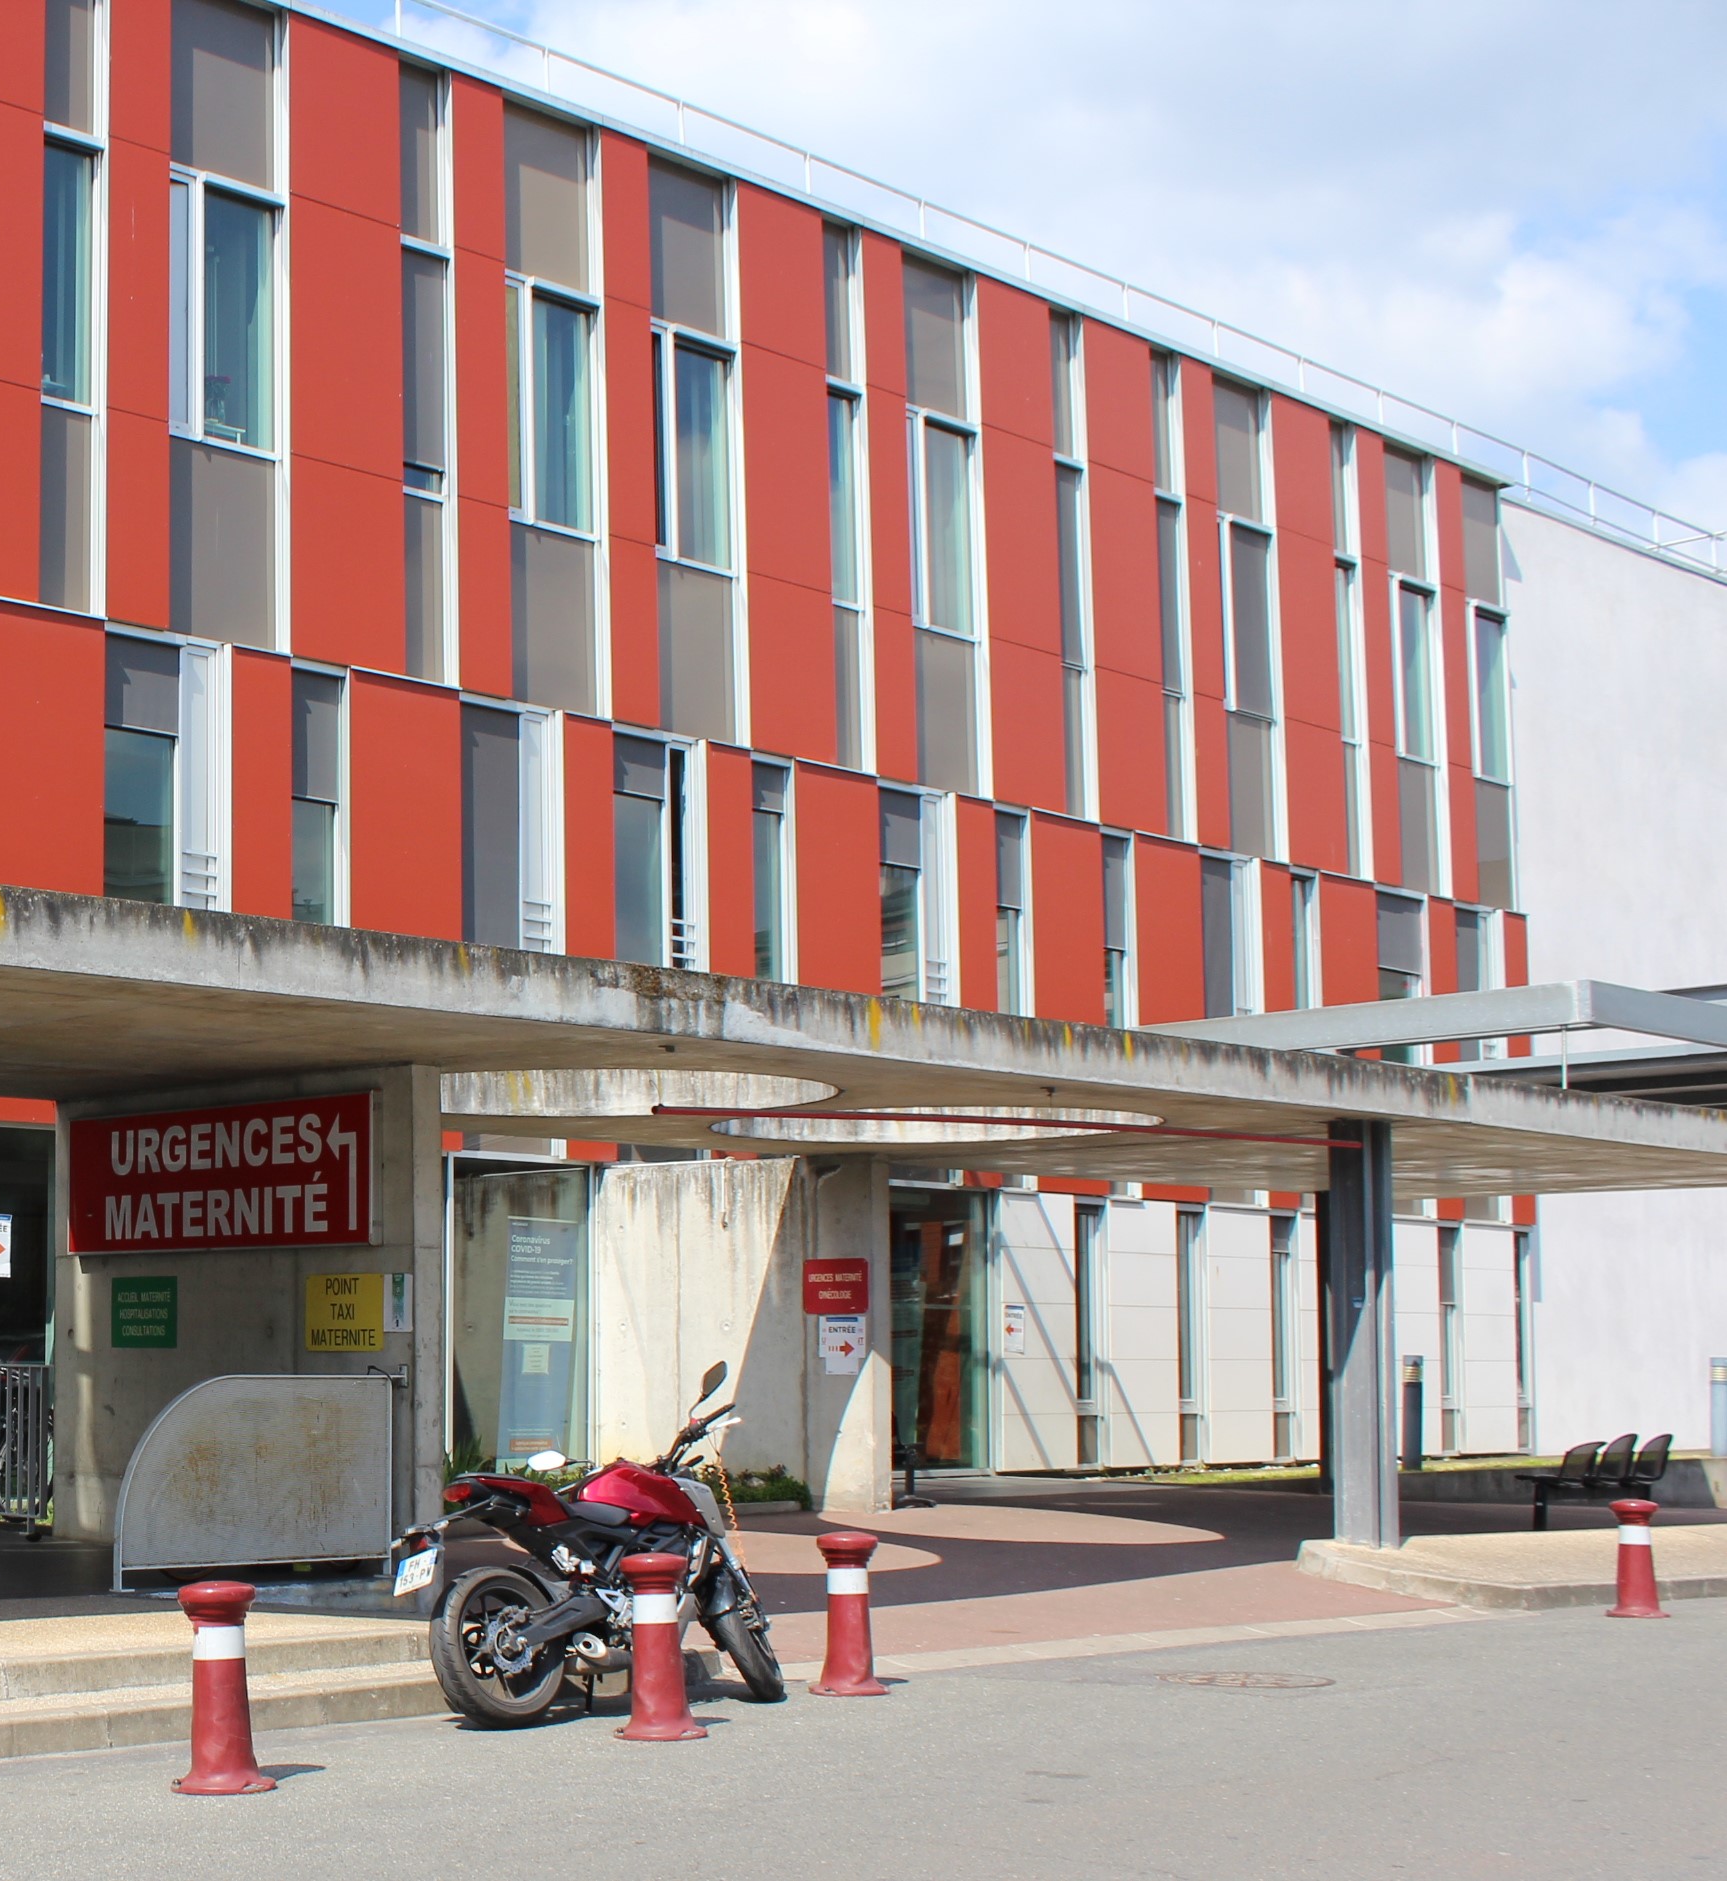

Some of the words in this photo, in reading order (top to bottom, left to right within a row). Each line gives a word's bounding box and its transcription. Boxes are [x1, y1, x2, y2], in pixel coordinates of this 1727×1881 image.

[111, 1113, 322, 1176] URGENCES
[105, 1171, 328, 1240] MATERNITÉ
[511, 1234, 551, 1245] Coronavirus
[511, 1244, 542, 1254] COVID-19
[808, 1273, 834, 1283] URGENCES
[325, 1277, 360, 1296] POINT
[330, 1303, 355, 1321] TAXI
[122, 1325, 166, 1337] CONSULTATIONS
[311, 1328, 376, 1346] MATERNITE
[828, 1325, 857, 1334] ENTRÉE
